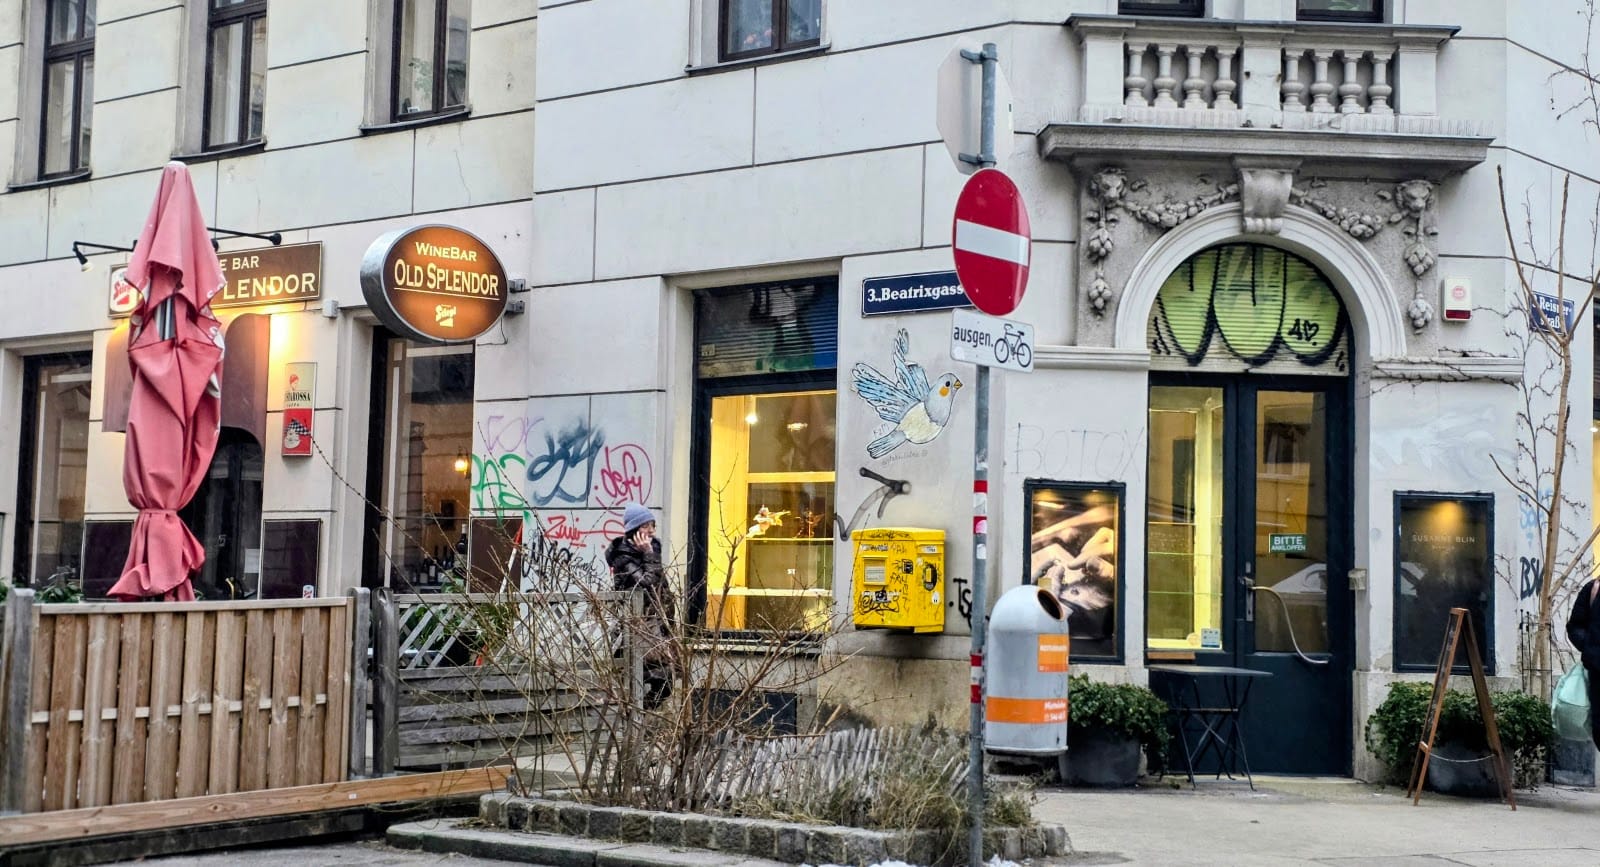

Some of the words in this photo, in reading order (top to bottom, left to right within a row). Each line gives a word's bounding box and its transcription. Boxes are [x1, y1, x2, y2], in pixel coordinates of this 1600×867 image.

[233, 255, 260, 270] BAR
[223, 272, 317, 301] LENDOR
[953, 325, 994, 349] ausgen.
[1273, 535, 1304, 546] BITTE
